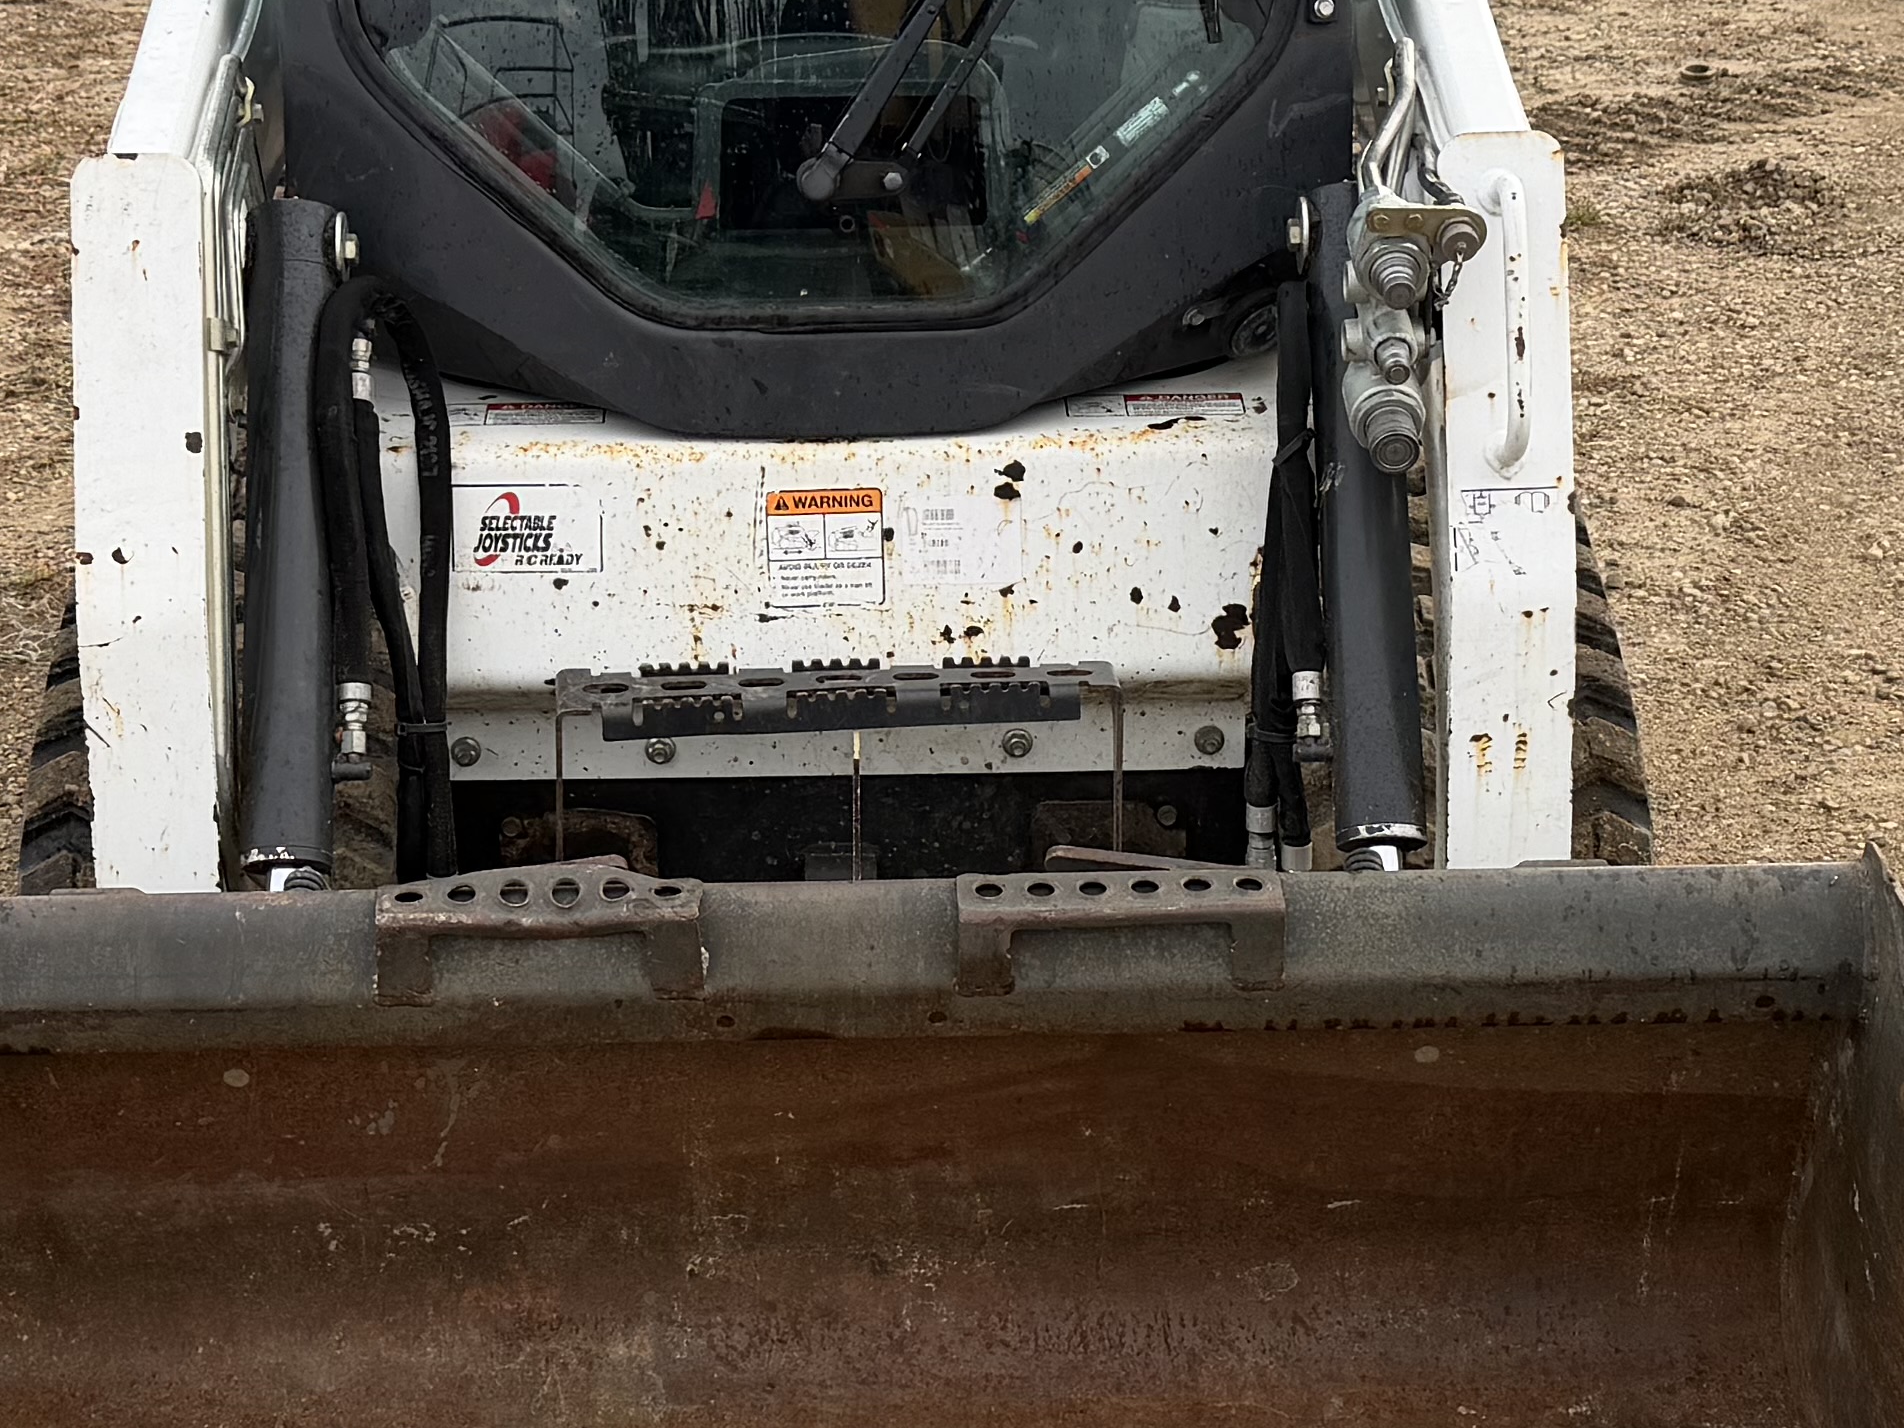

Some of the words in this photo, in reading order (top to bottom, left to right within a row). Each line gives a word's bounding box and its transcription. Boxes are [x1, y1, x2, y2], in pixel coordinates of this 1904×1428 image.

[793, 493, 874, 509] WARNING
[479, 515, 557, 532] SELECTABLE
[473, 533, 553, 553] JOYSTICKS
